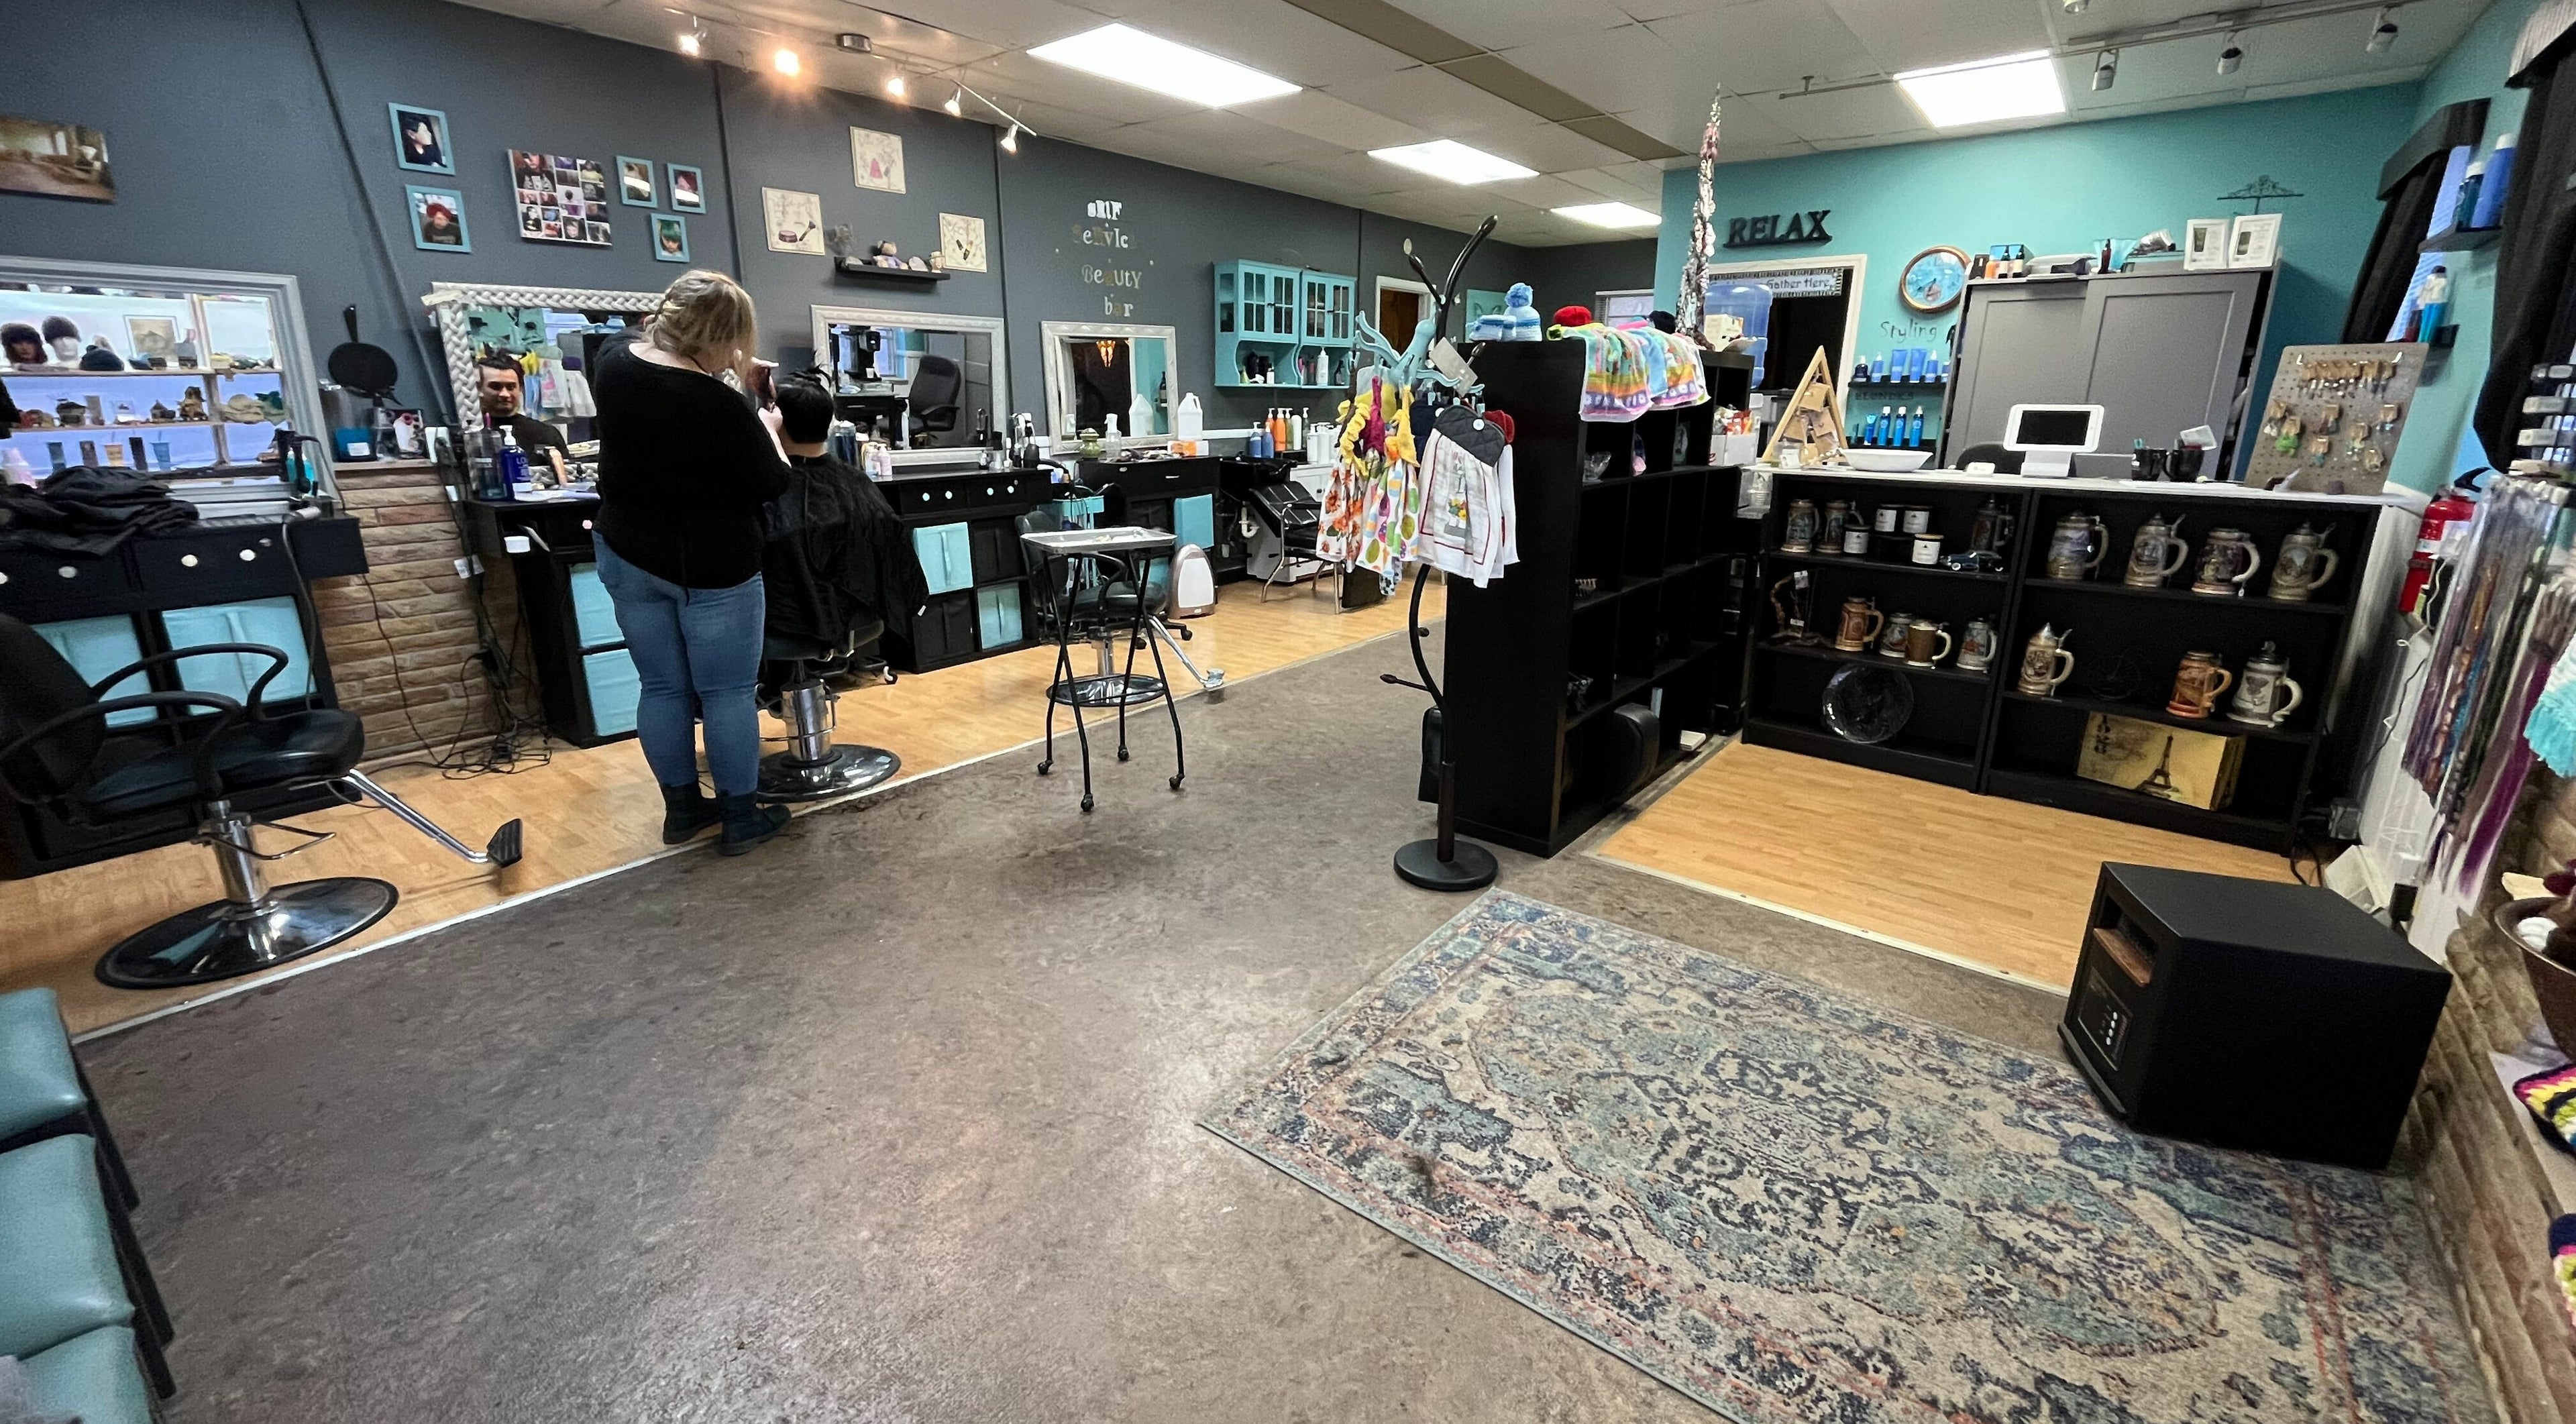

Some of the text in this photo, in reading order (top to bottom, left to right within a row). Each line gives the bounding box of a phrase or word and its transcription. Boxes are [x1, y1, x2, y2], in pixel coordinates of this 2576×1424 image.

[1727, 209, 1832, 245] RELAX
[1766, 279, 1801, 289] Gather
[1104, 295, 1134, 317] bar
[1880, 318, 1937, 343] Styling
